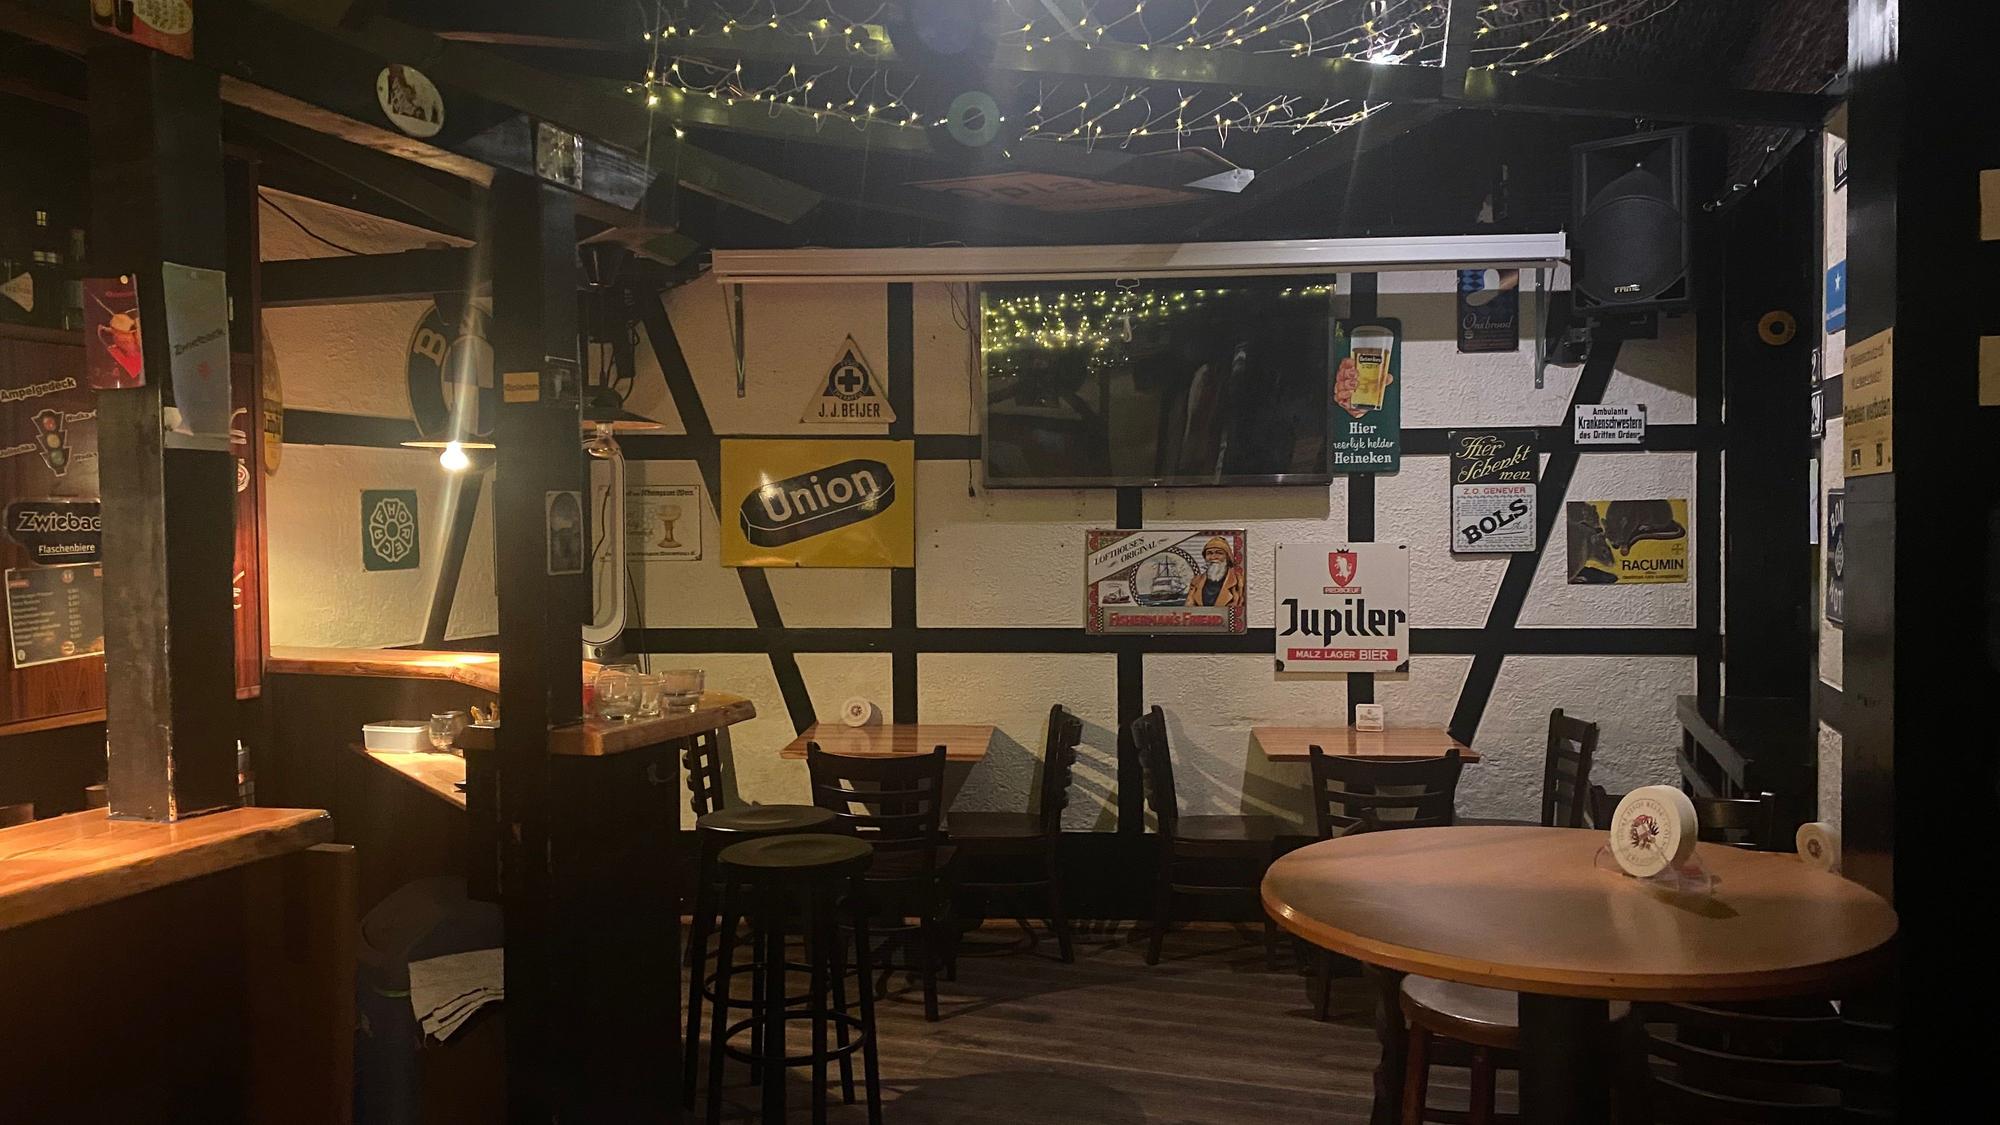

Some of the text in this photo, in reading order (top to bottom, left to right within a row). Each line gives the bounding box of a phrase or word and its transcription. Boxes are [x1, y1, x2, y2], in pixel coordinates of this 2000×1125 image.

[1592, 407, 1629, 416] Ambulante
[1350, 422, 1377, 434] Hier
[1578, 416, 1643, 430] Krankenschwestern
[1579, 431, 1591, 440] des
[1593, 431, 1616, 440] Dritten
[1455, 435, 1506, 461] Hier
[1334, 452, 1393, 464] Heineken
[1457, 444, 1532, 483] Schenkt
[1499, 470, 1532, 481] men
[759, 471, 880, 522] Union
[1483, 486, 1526, 495] GENEVER
[1461, 498, 1529, 545] BOLS
[39, 544, 97, 555] Flaschenbiere
[1120, 541, 1157, 564] ORIGINAL
[1621, 558, 1685, 571] RACUMIN
[1279, 598, 1407, 648] Jupiler
[1296, 649, 1390, 660] MALZ LAGER BIER
